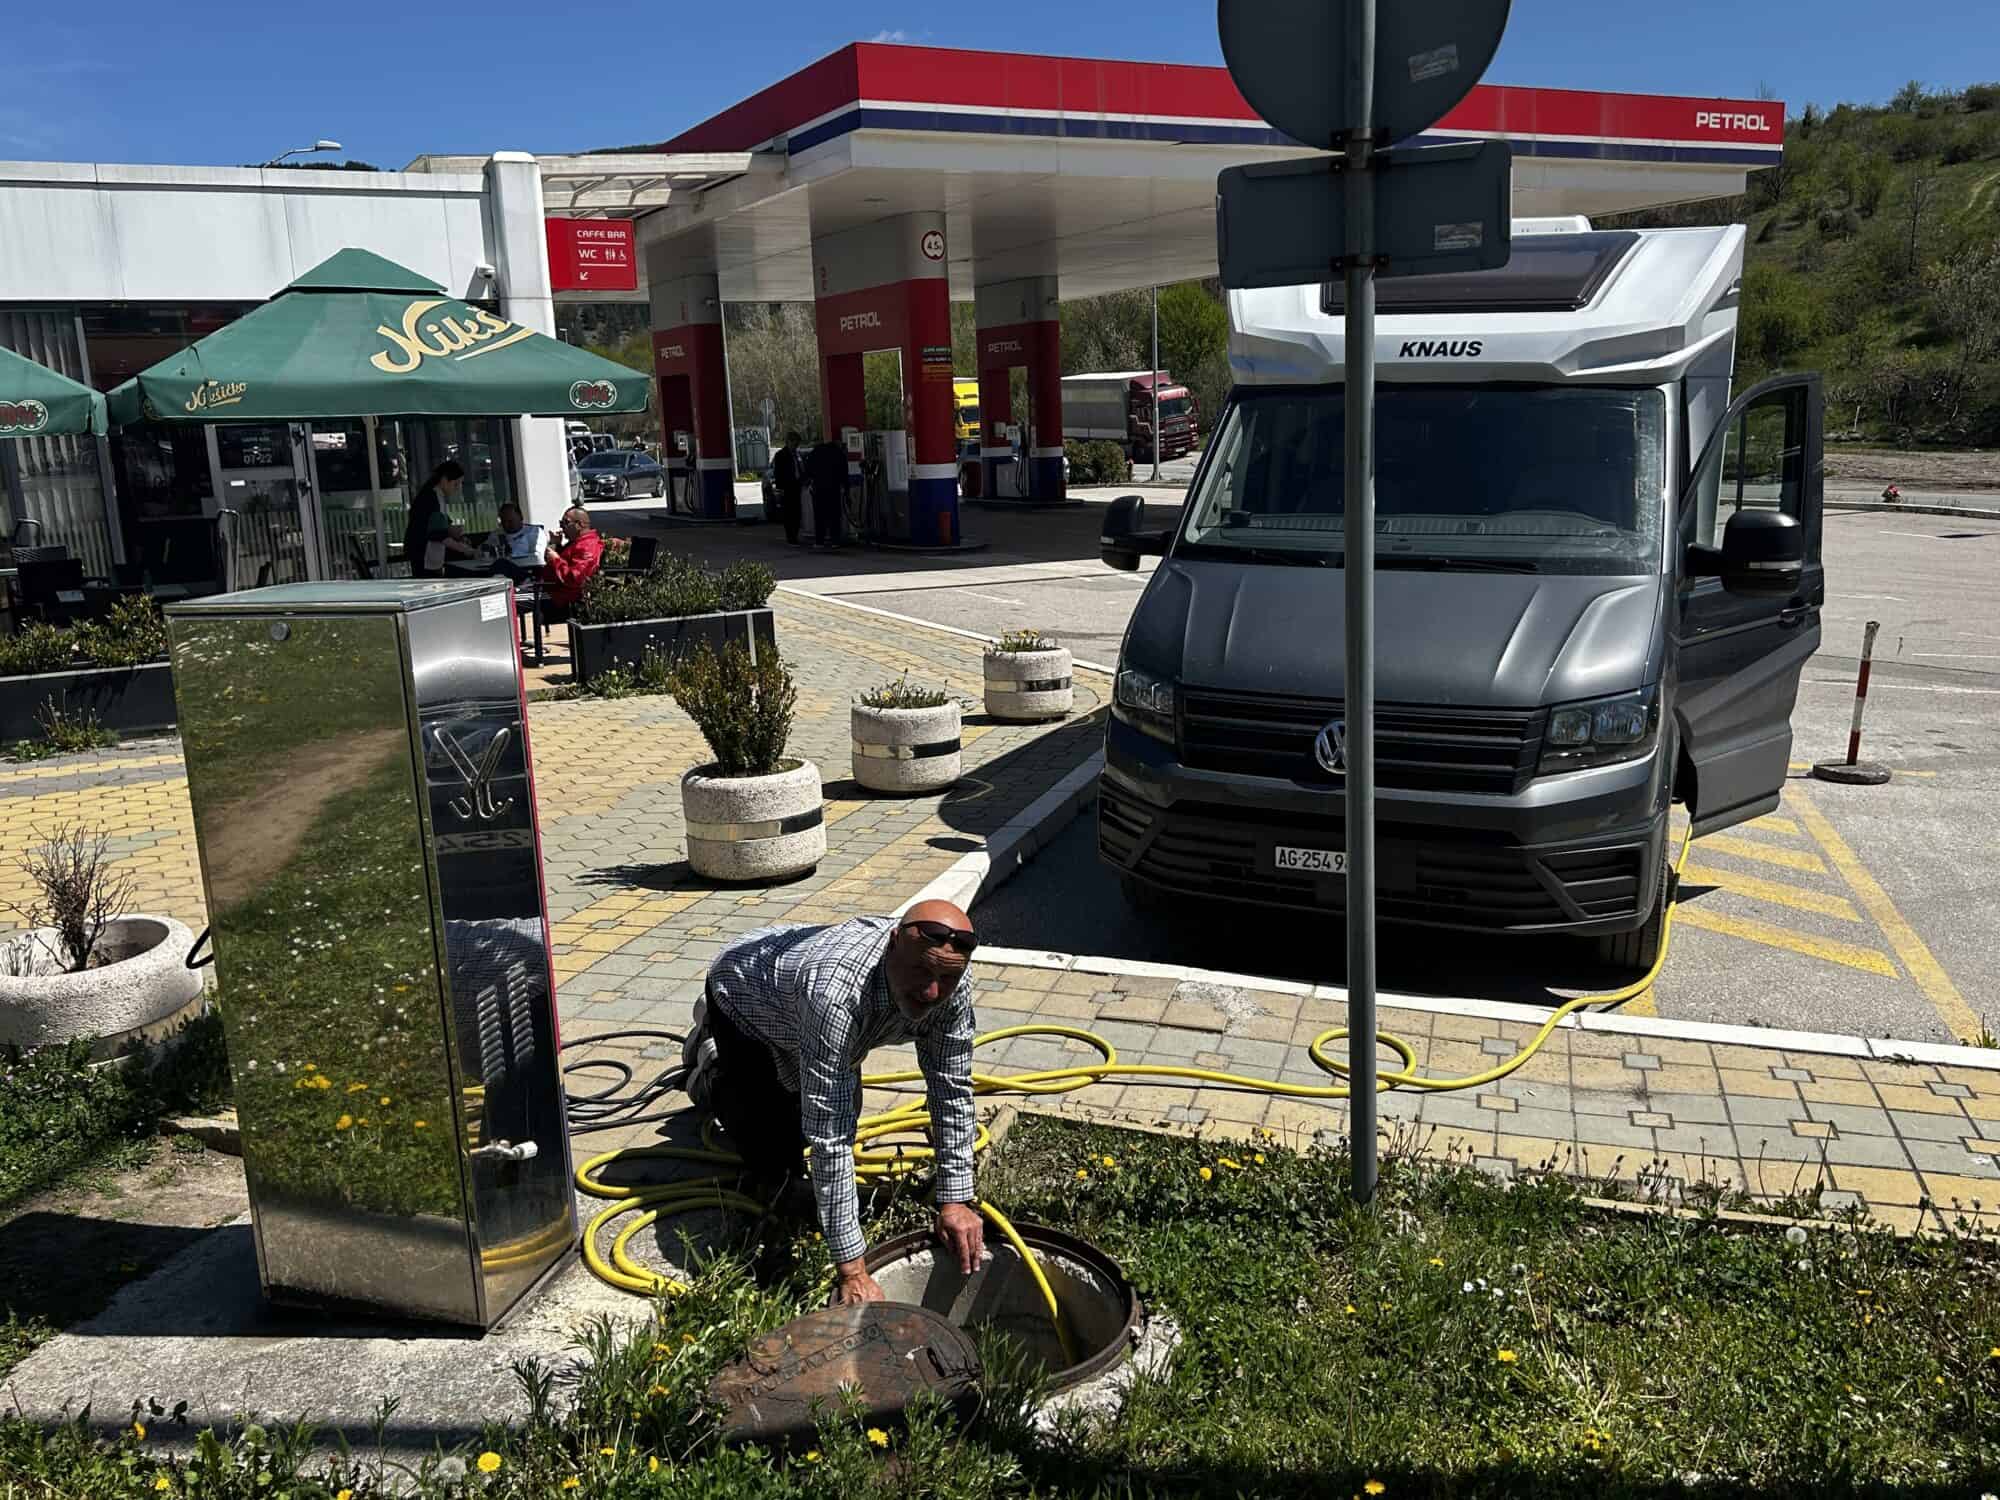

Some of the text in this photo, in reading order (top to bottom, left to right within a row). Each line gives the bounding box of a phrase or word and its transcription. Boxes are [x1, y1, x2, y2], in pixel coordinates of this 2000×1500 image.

[1696, 111, 1771, 131] PETROL
[576, 230, 627, 239] CAFFE BAR
[578, 249, 598, 259] WC
[839, 312, 881, 333] PETROL
[660, 345, 685, 359] PETROL
[986, 341, 1023, 353] PETROL
[1399, 341, 1483, 358] KNAUS
